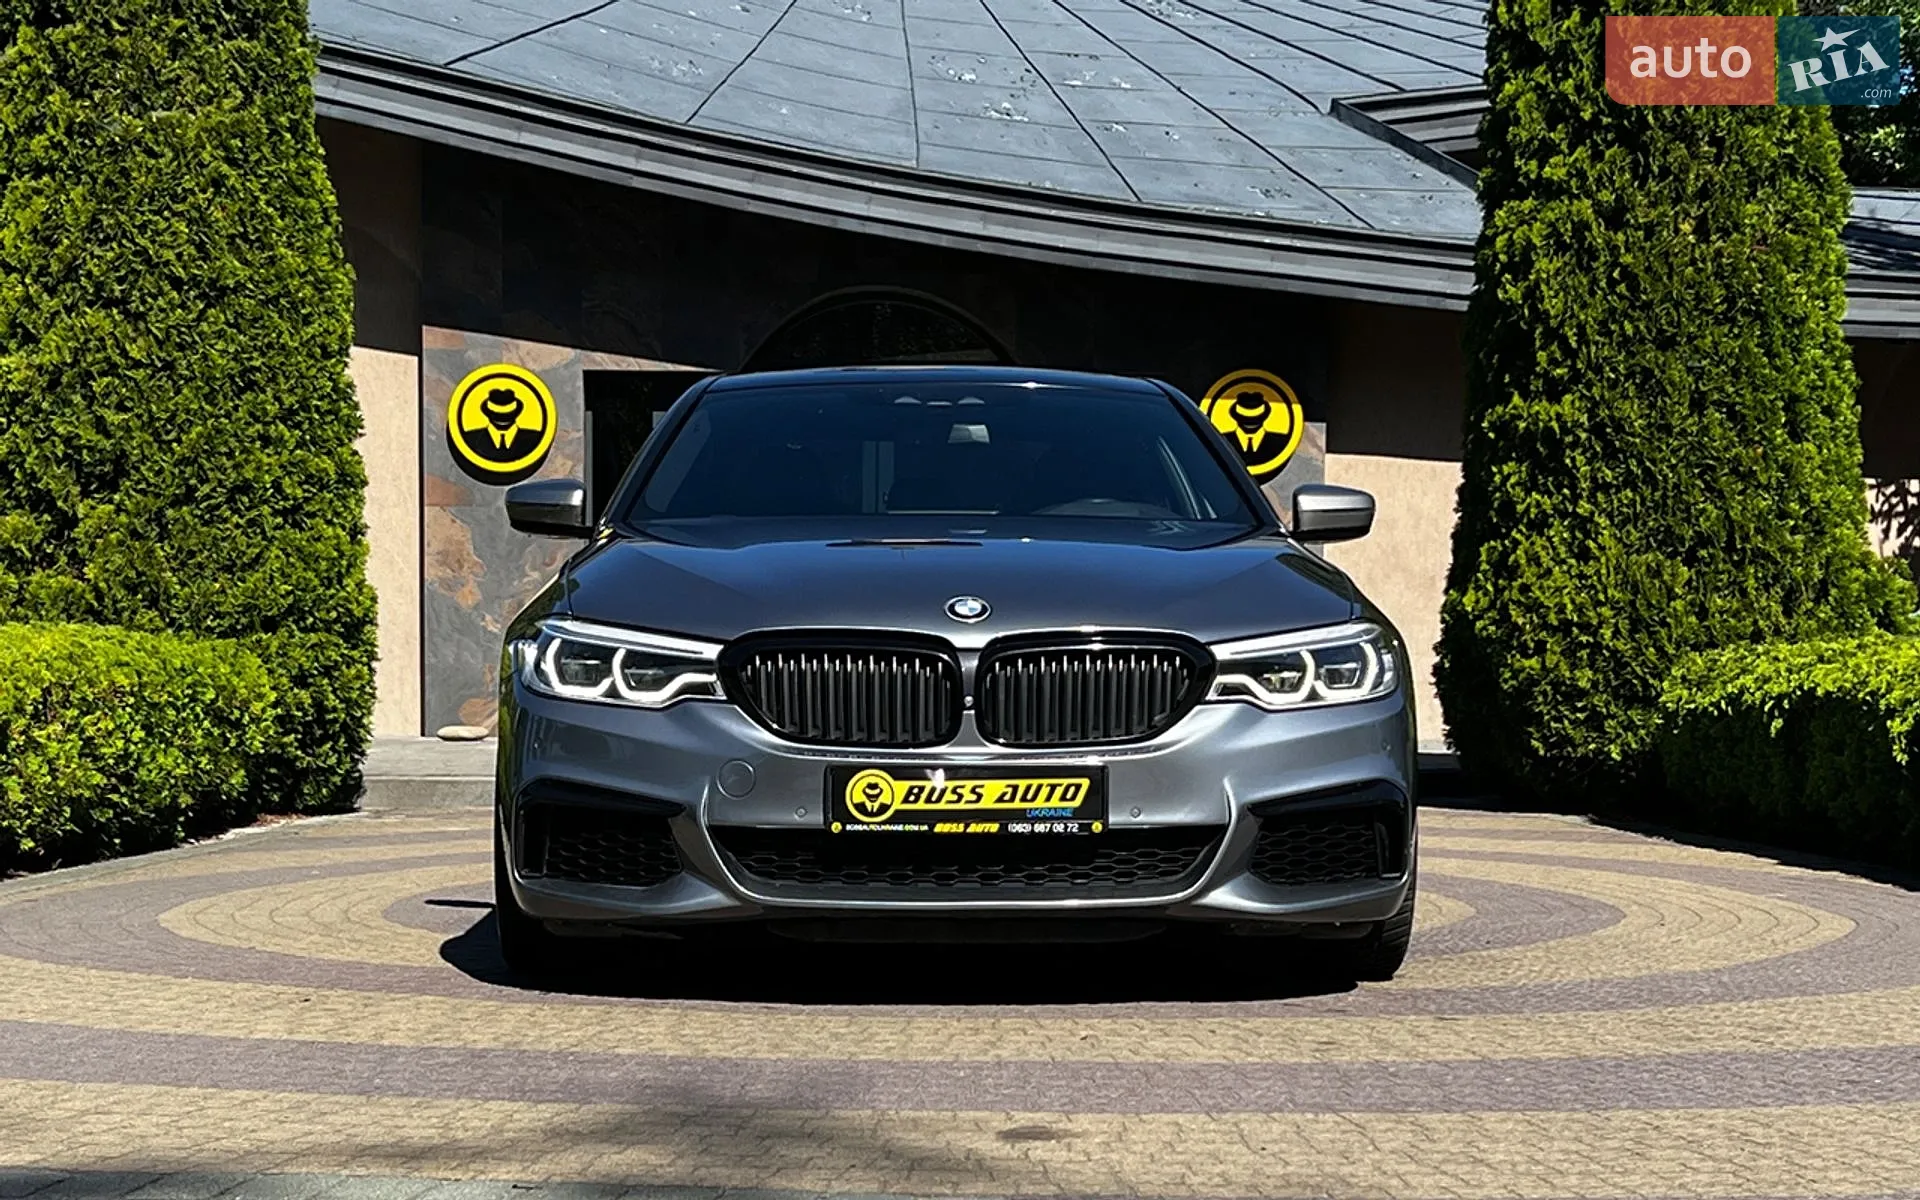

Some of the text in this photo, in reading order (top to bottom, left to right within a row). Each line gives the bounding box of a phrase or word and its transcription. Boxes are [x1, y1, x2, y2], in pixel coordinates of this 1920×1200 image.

[993, 782, 1083, 804] AUTO
[1026, 807, 1074, 818] UKRAINE
[966, 823, 1000, 833] AUTO
[1066, 823, 1079, 833] 72
